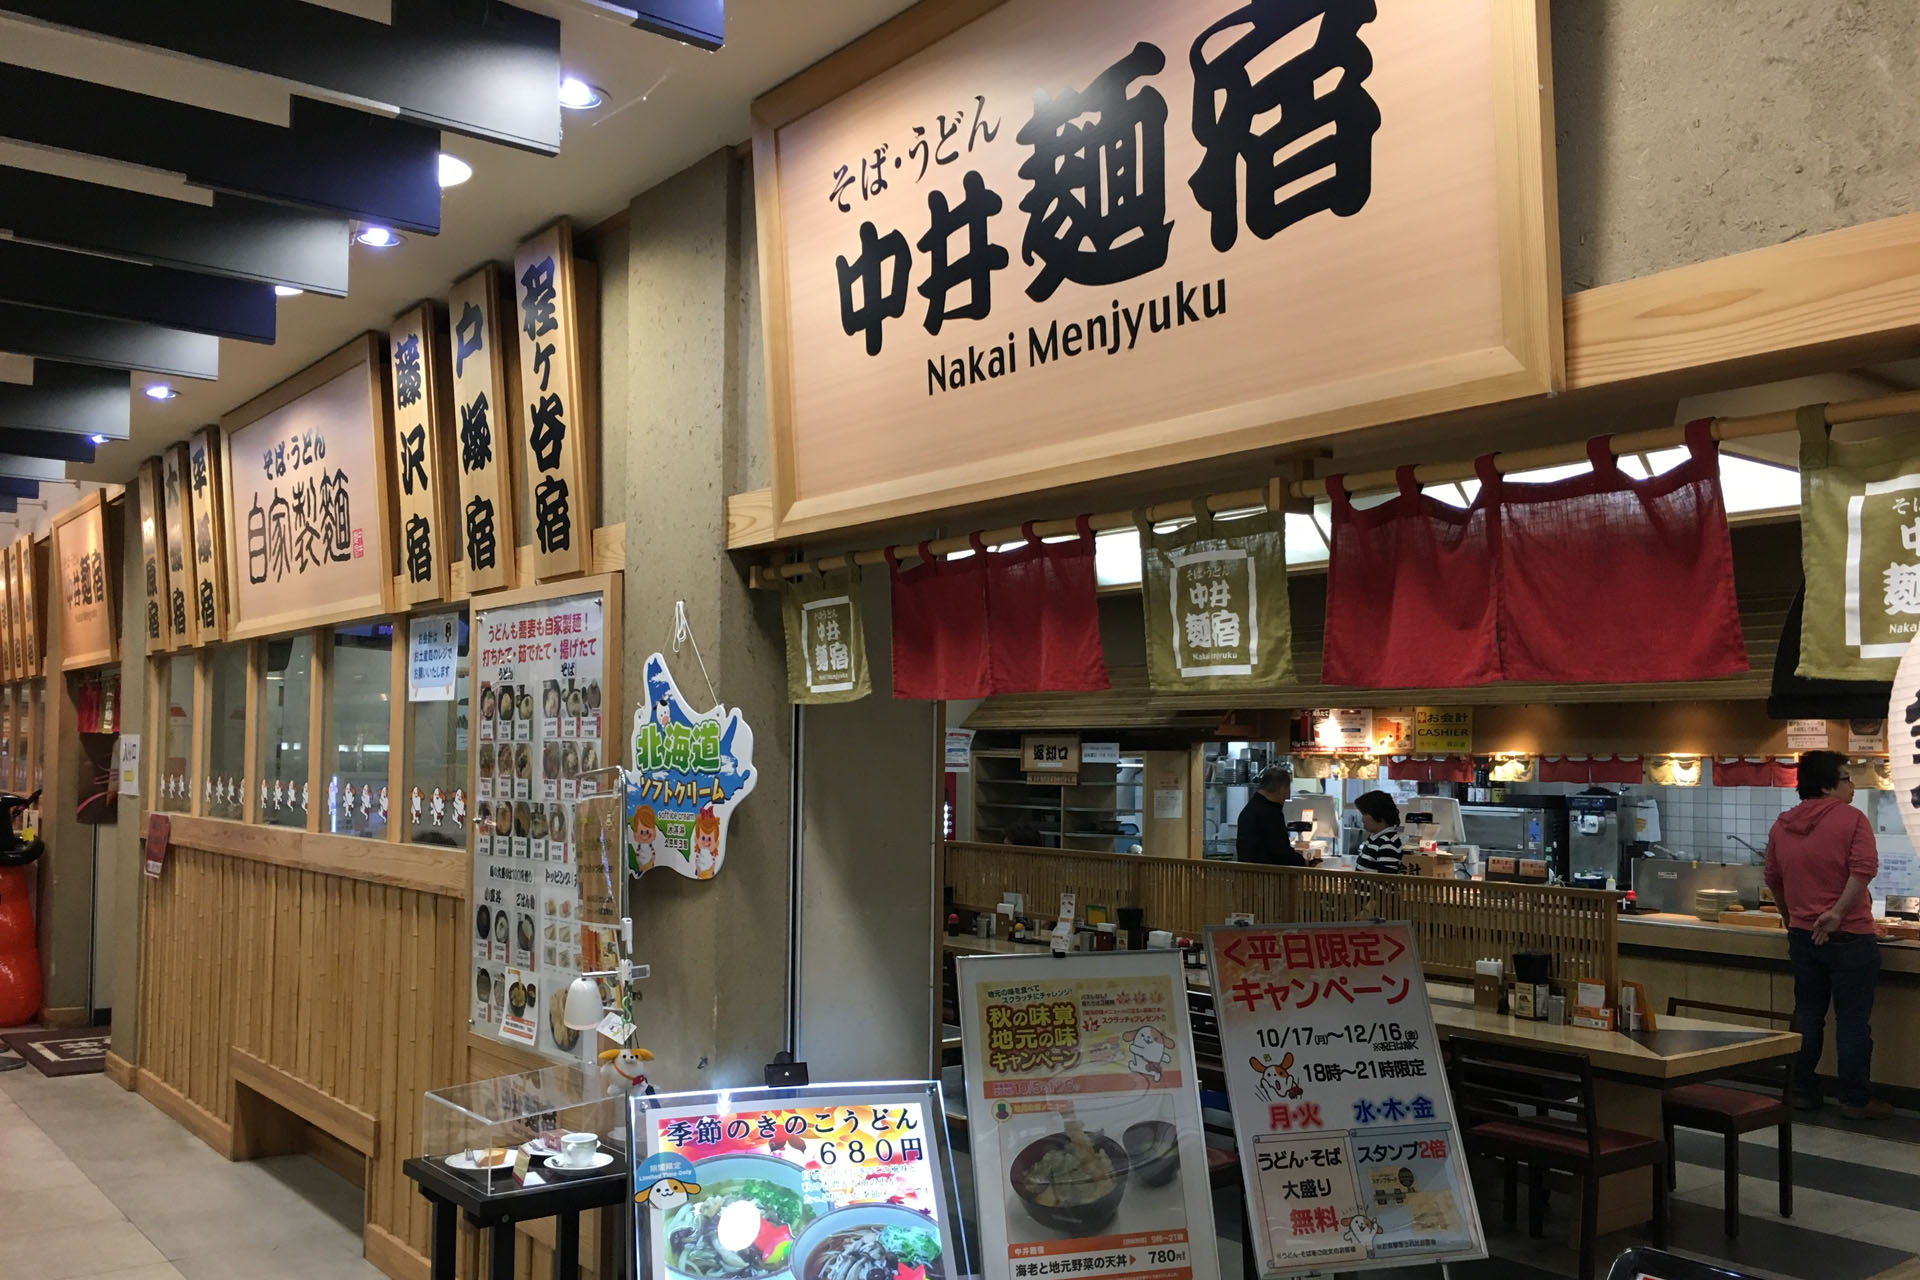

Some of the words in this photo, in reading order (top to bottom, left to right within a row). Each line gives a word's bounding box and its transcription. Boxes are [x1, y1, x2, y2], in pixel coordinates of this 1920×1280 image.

[829, 96, 1001, 212] そば・うどん
[927, 332, 1016, 396] Nakai
[1029, 278, 1227, 367] Menjyuku
[263, 425, 326, 481] そば・うどん
[395, 333, 432, 584] 藤沢宿
[1892, 497, 1920, 514] そ
[1189, 580, 1231, 609] 中井
[561, 662, 575, 677] そば
[1426, 711, 1468, 724] お会計
[1417, 728, 1469, 738] CASHIER
[636, 720, 721, 774] 北海道
[1033, 744, 1069, 761] 返却口
[640, 776, 725, 805] ソフトクリーム
[545, 868, 571, 885] トッピング
[1231, 975, 1410, 1012] キャンペーン
[988, 1002, 1076, 1030] 秋の味覚
[991, 1026, 1078, 1051] 地元の味
[991, 1049, 1080, 1074] キャンペーン
[1270, 1103, 1324, 1130] 月・火
[1354, 1097, 1435, 1124] 水・木・金
[666, 1108, 918, 1147] 季節のきのこうどん
[1258, 1148, 1342, 1171] うどん・そば
[1358, 1140, 1447, 1164] スタンプ2倍
[1282, 1178, 1332, 1200] 大盛り
[1290, 1205, 1339, 1236] 無料
[1015, 1254, 1128, 1278] 海老と地元野菜の天丼
